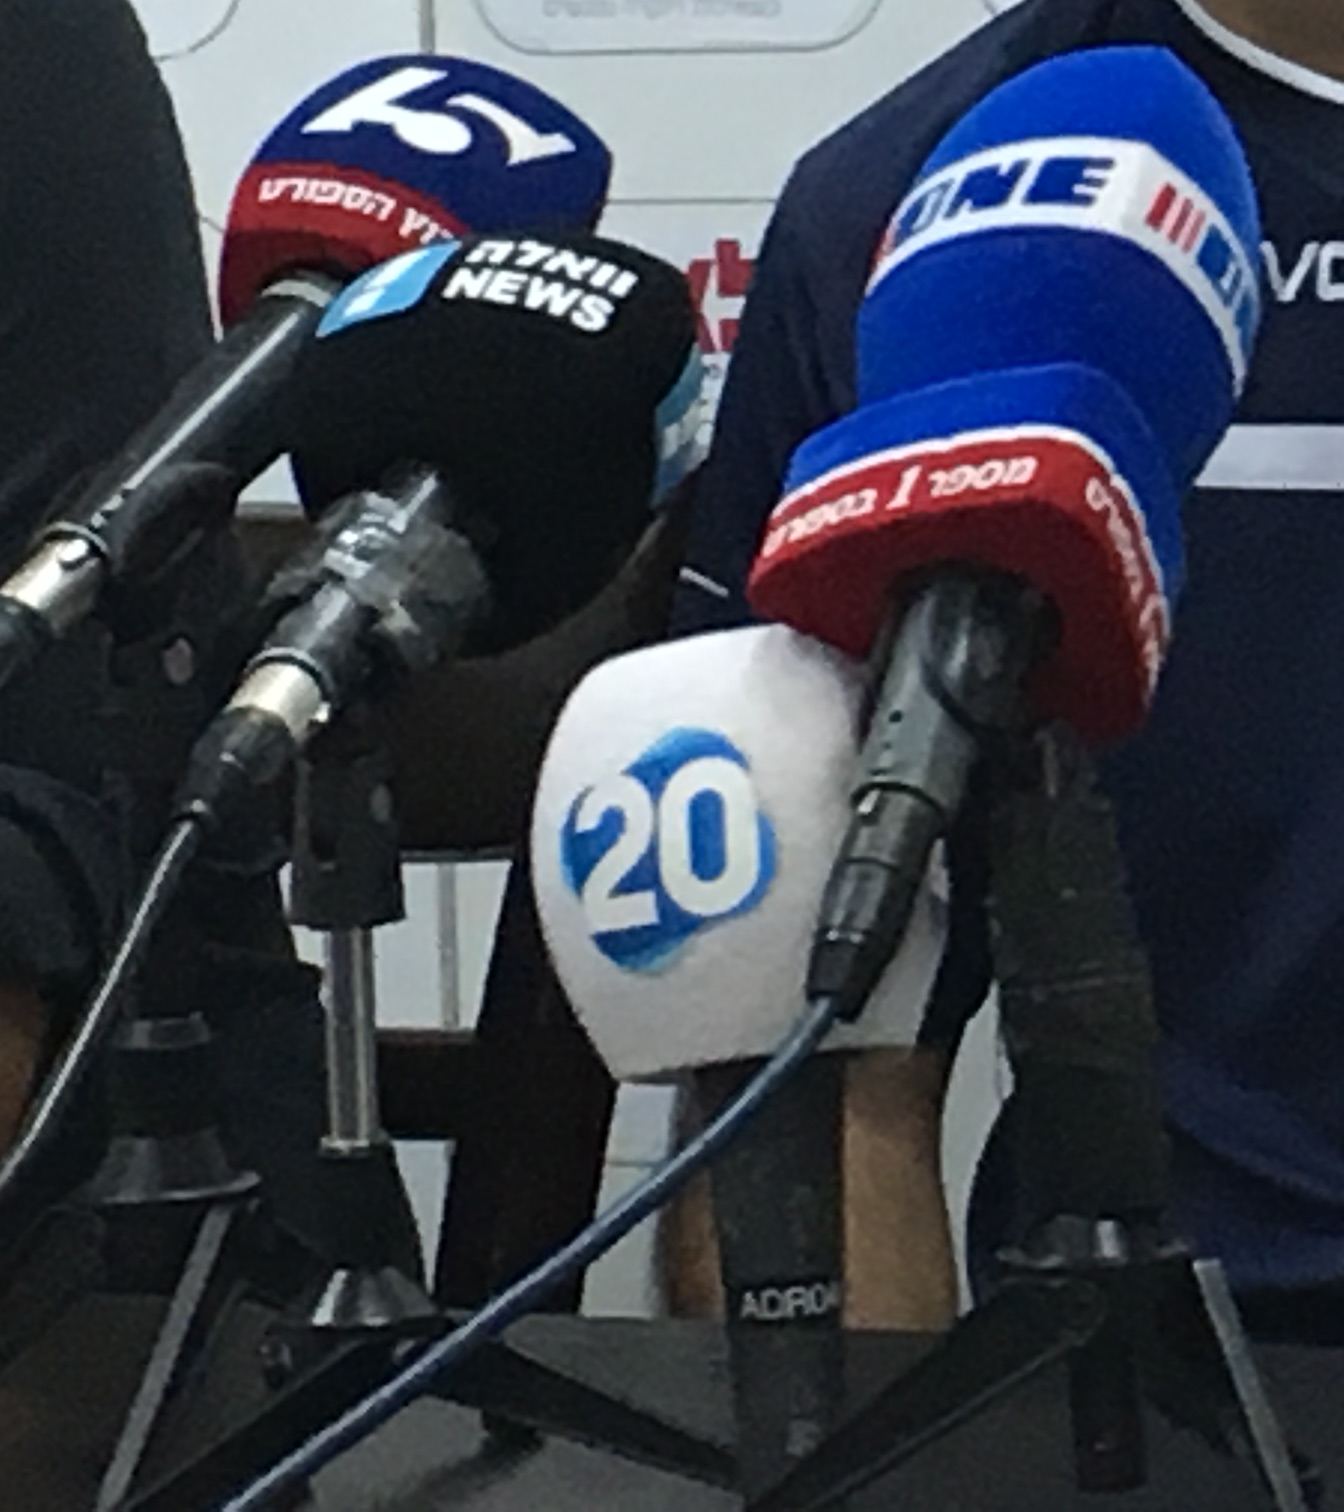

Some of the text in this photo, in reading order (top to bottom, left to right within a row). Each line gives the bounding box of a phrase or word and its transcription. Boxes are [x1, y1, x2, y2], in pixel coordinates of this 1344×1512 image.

[258, 177, 396, 221] הספורט
[896, 156, 1117, 240] ONE
[442, 267, 616, 333] NEWS
[465, 239, 640, 300] וואלה
[574, 756, 760, 931] 20
